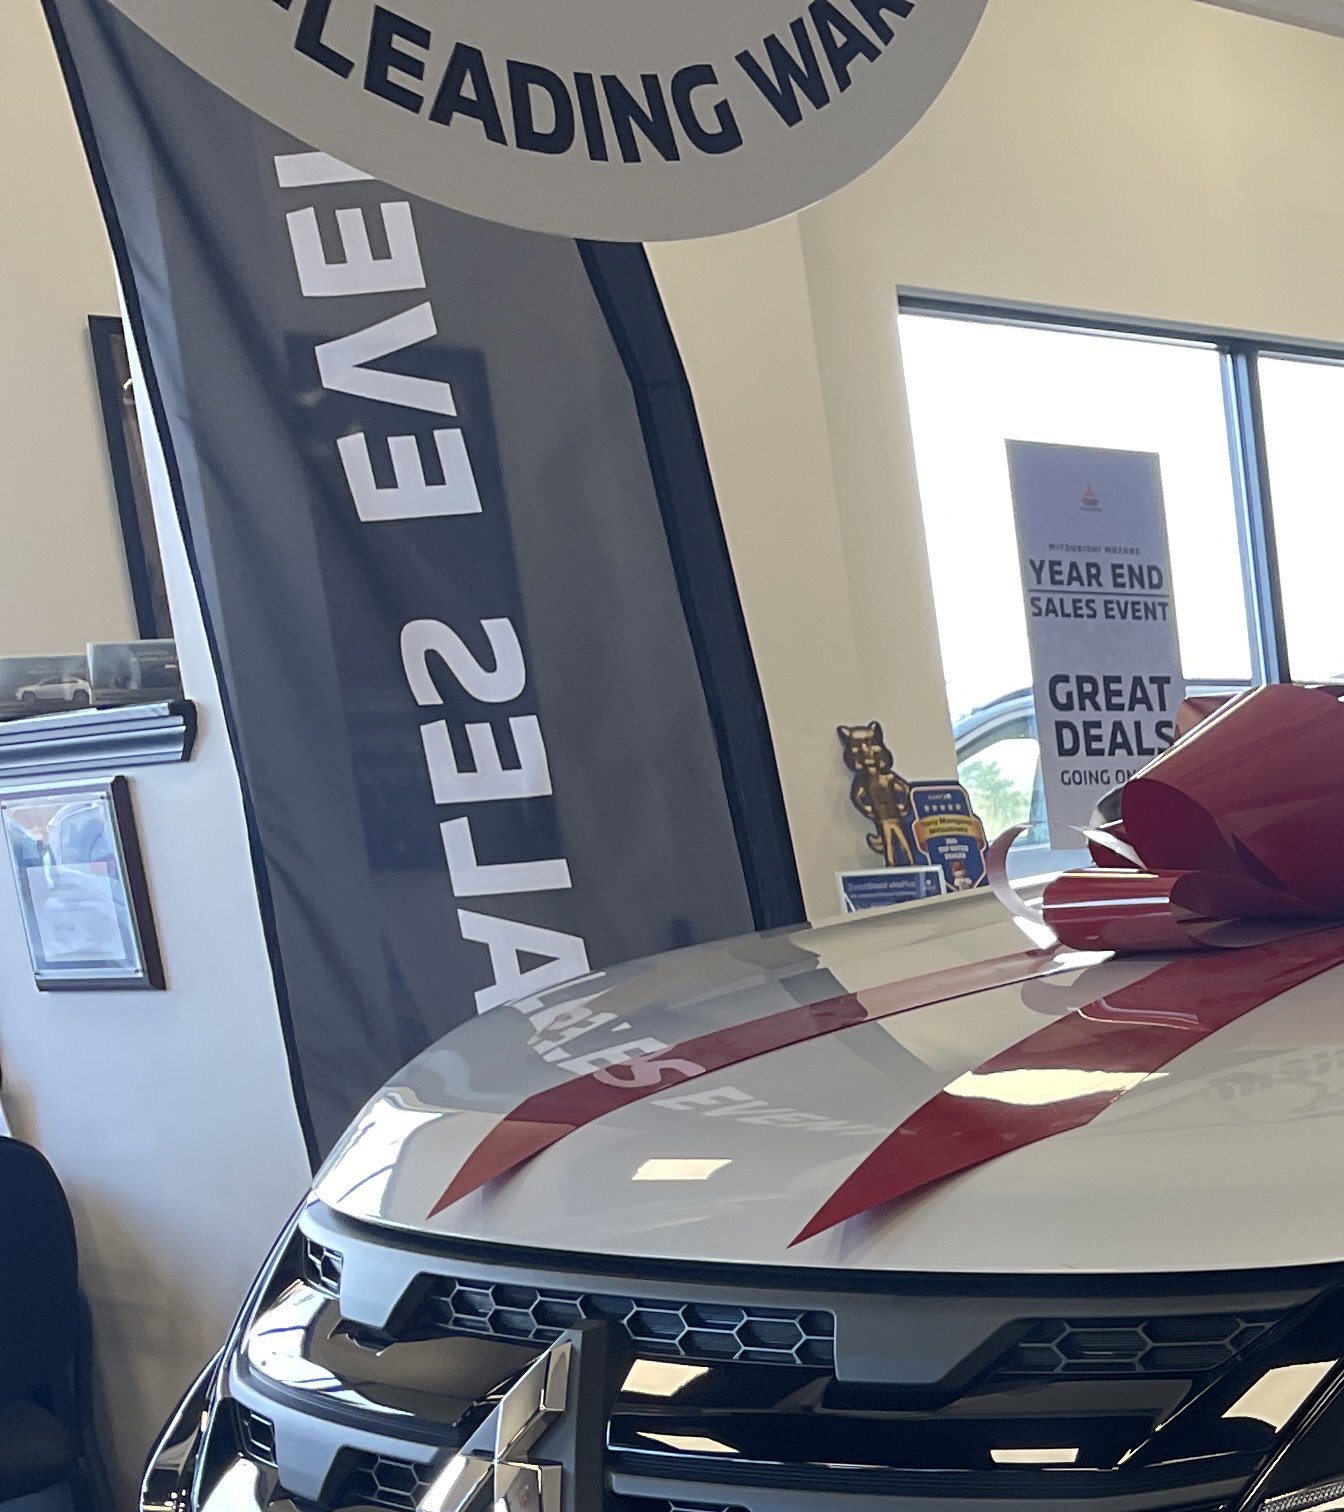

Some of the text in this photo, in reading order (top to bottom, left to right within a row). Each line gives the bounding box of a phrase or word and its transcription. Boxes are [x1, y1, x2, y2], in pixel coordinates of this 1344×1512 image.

[1048, 543, 1140, 555] MITSUBISHI MOTORS
[1029, 559, 1164, 590] YEAR END
[1030, 597, 1169, 621] SALES EVENT
[1048, 673, 1171, 712] GREAT
[1054, 720, 1176, 757] DEALS
[1060, 769, 1111, 786] GOING
